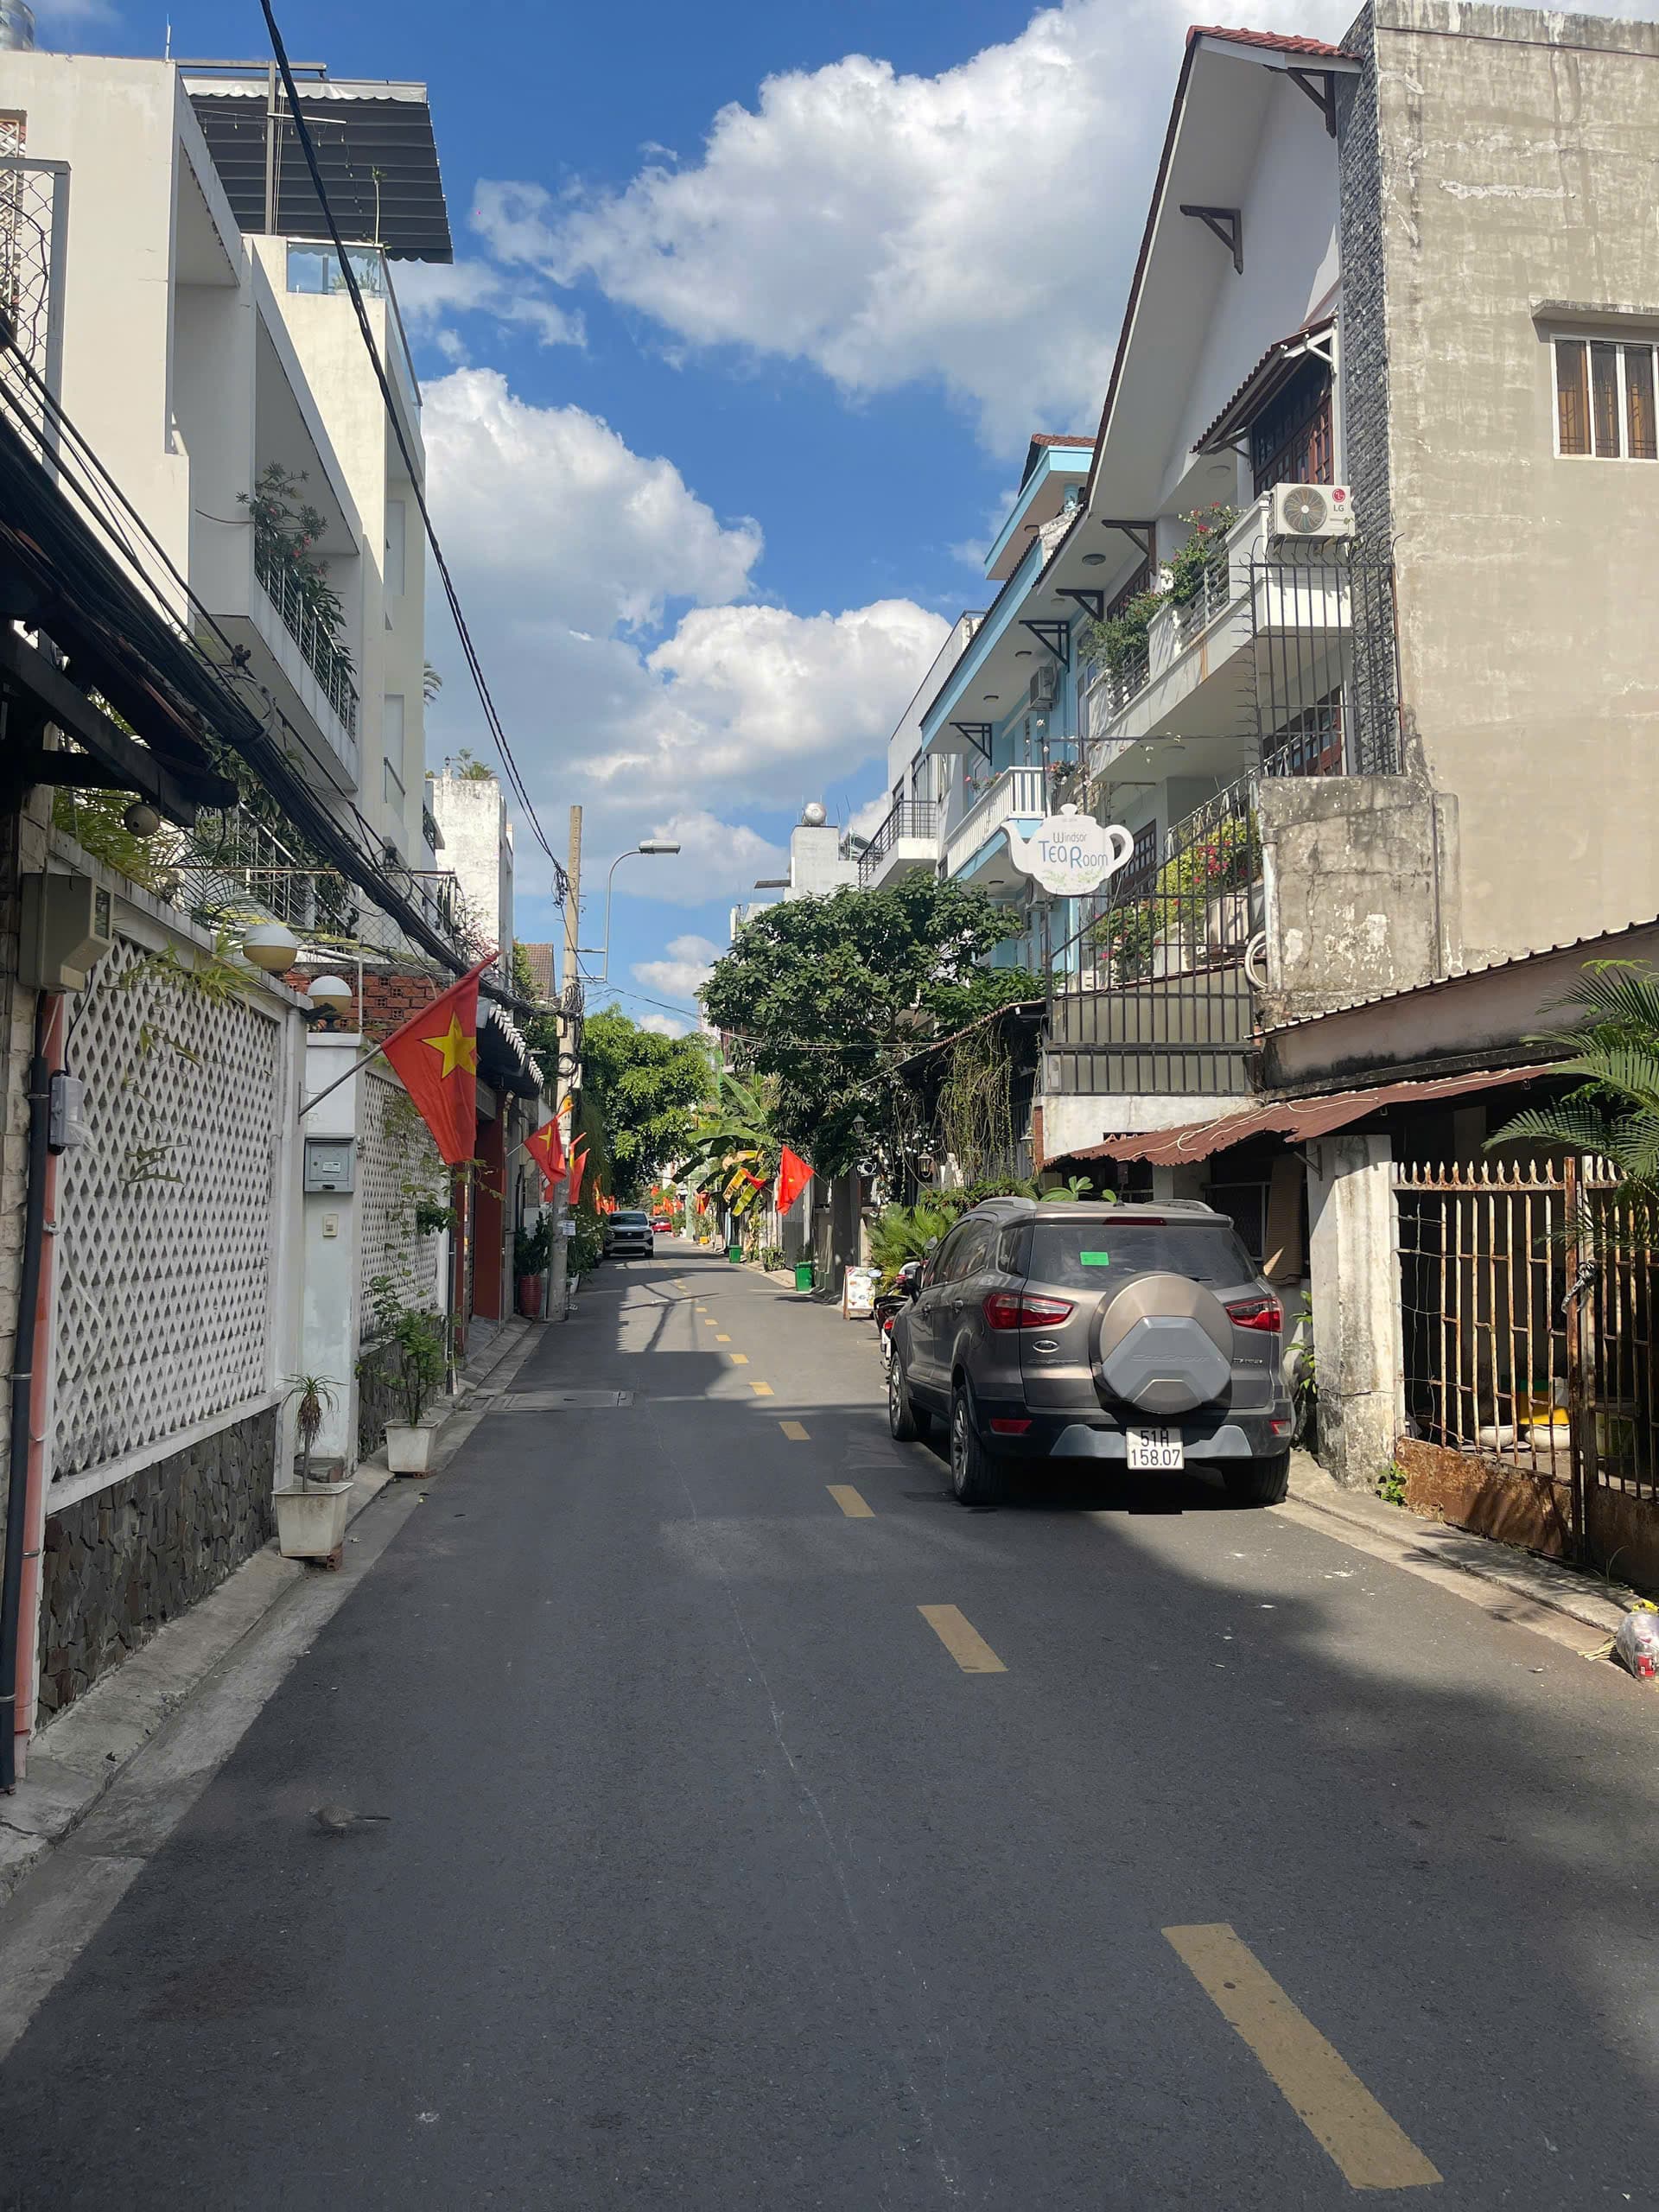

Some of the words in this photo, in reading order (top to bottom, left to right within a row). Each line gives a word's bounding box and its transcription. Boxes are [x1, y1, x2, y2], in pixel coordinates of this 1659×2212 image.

[1052, 831, 1087, 843] Windsor
[1140, 1430, 1169, 1447] 51H
[1131, 1449, 1180, 1466] 158.07
